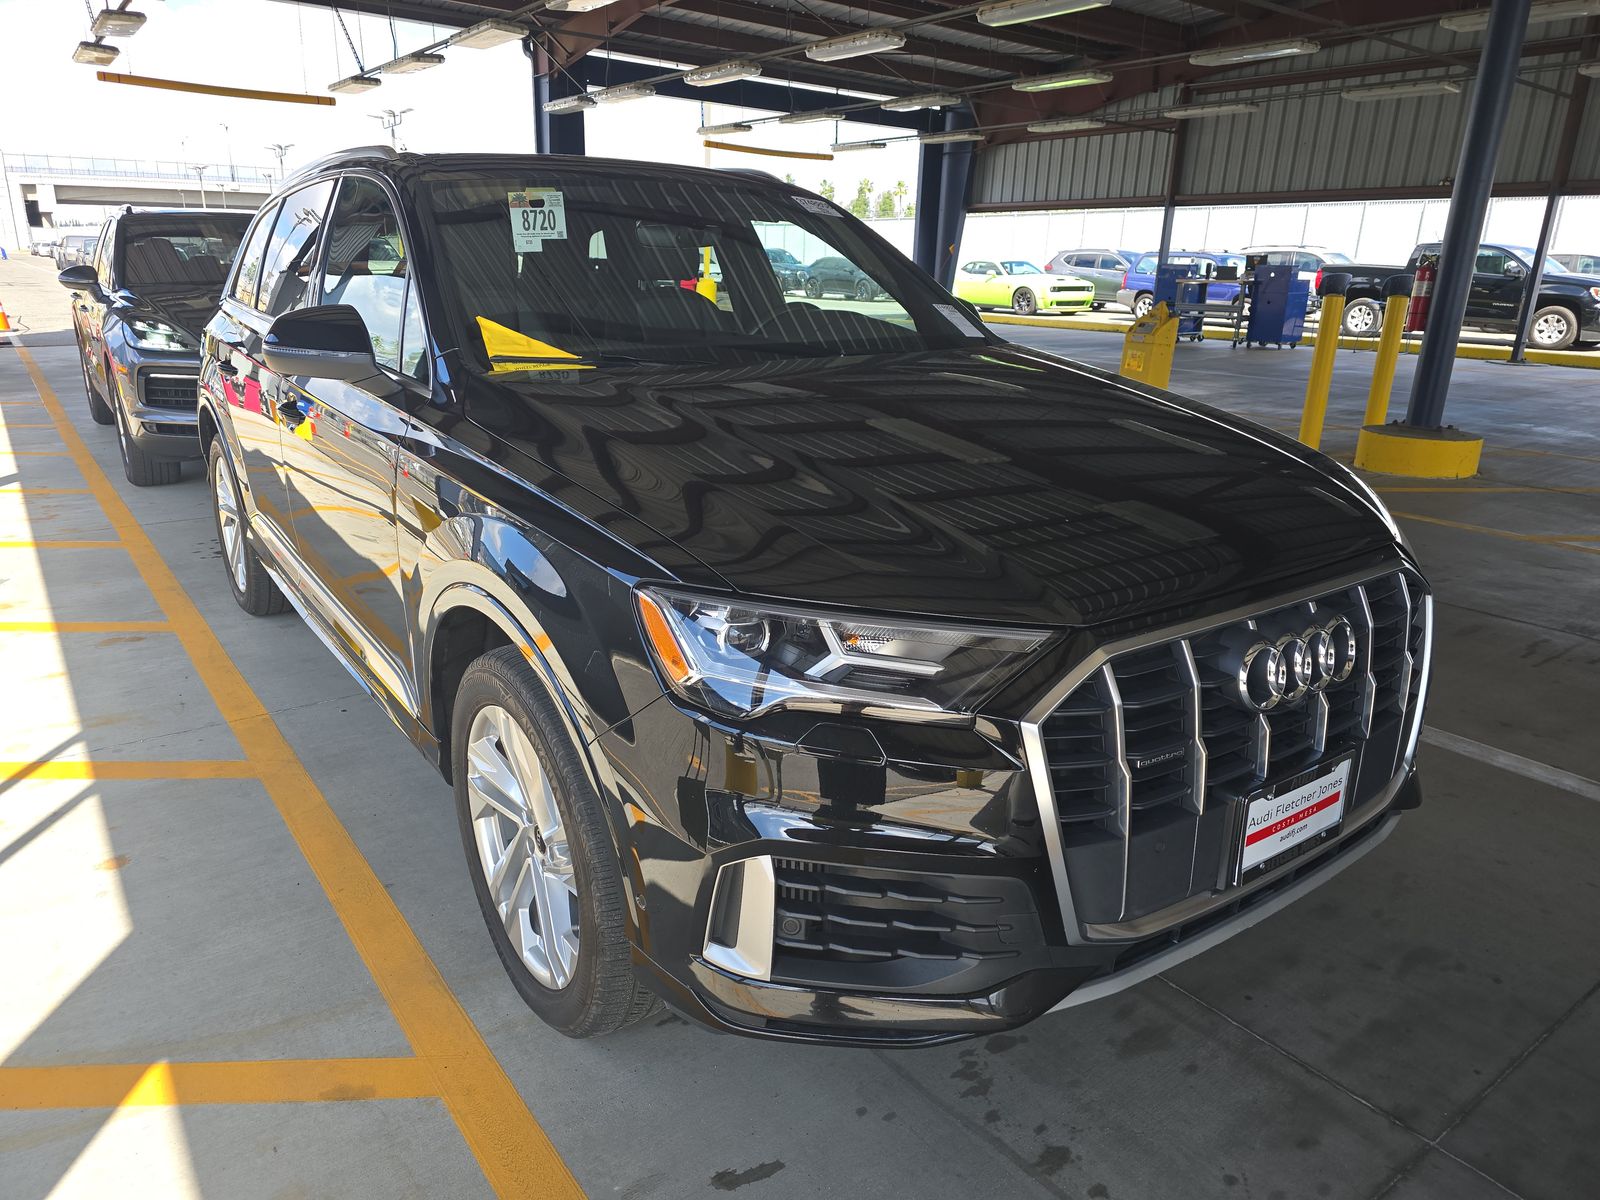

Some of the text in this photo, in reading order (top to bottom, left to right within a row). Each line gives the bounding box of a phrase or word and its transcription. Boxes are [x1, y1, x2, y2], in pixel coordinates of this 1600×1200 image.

[521, 209, 557, 231] 8720
[1140, 750, 1183, 766] quattro
[1248, 777, 1343, 829] Audi Fletcher Jones
[1272, 806, 1317, 833] COSTA MESA
